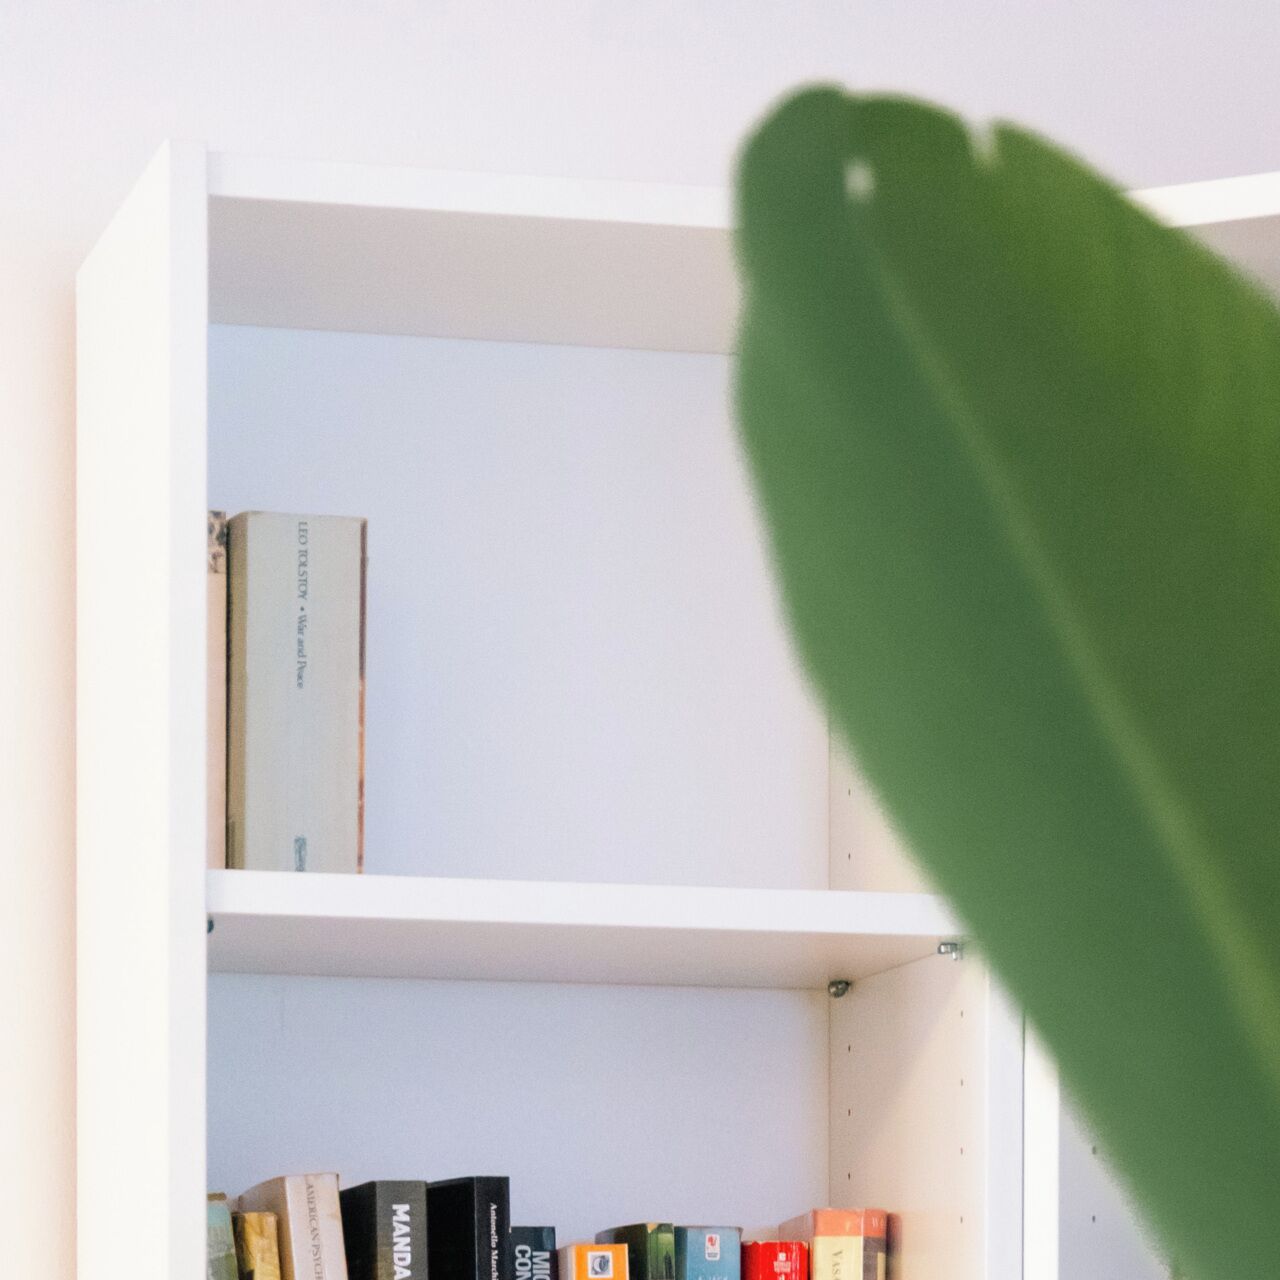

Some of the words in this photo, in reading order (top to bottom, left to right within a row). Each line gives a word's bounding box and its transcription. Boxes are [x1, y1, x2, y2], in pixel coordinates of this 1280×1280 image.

[298, 521, 308, 545] LEO
[297, 550, 309, 601] TOLSTOY
[297, 615, 308, 639] War
[305, 1183, 321, 1244] AMERICAN
